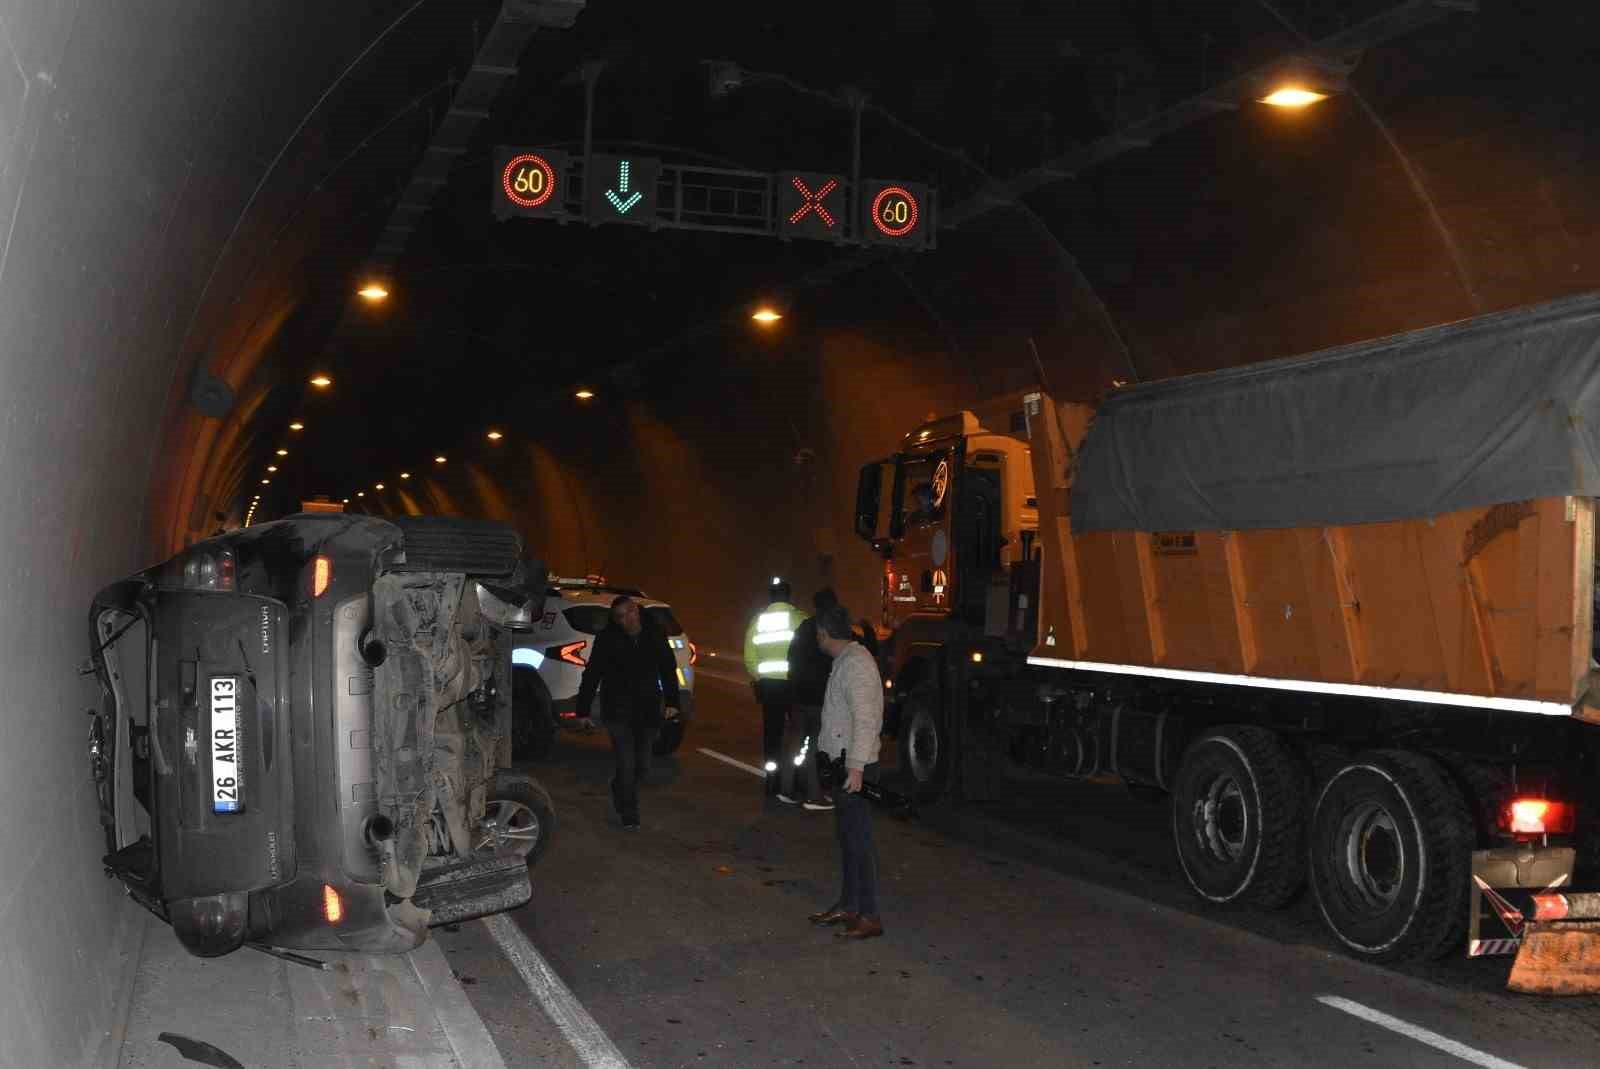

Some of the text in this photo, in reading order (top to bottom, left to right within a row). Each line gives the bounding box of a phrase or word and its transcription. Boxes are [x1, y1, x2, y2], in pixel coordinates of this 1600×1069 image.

[515, 168, 542, 192] 60
[883, 200, 907, 222] 60
[214, 680, 234, 713] 113
[214, 729, 235, 763] AKR
[217, 777, 236, 800] 26
